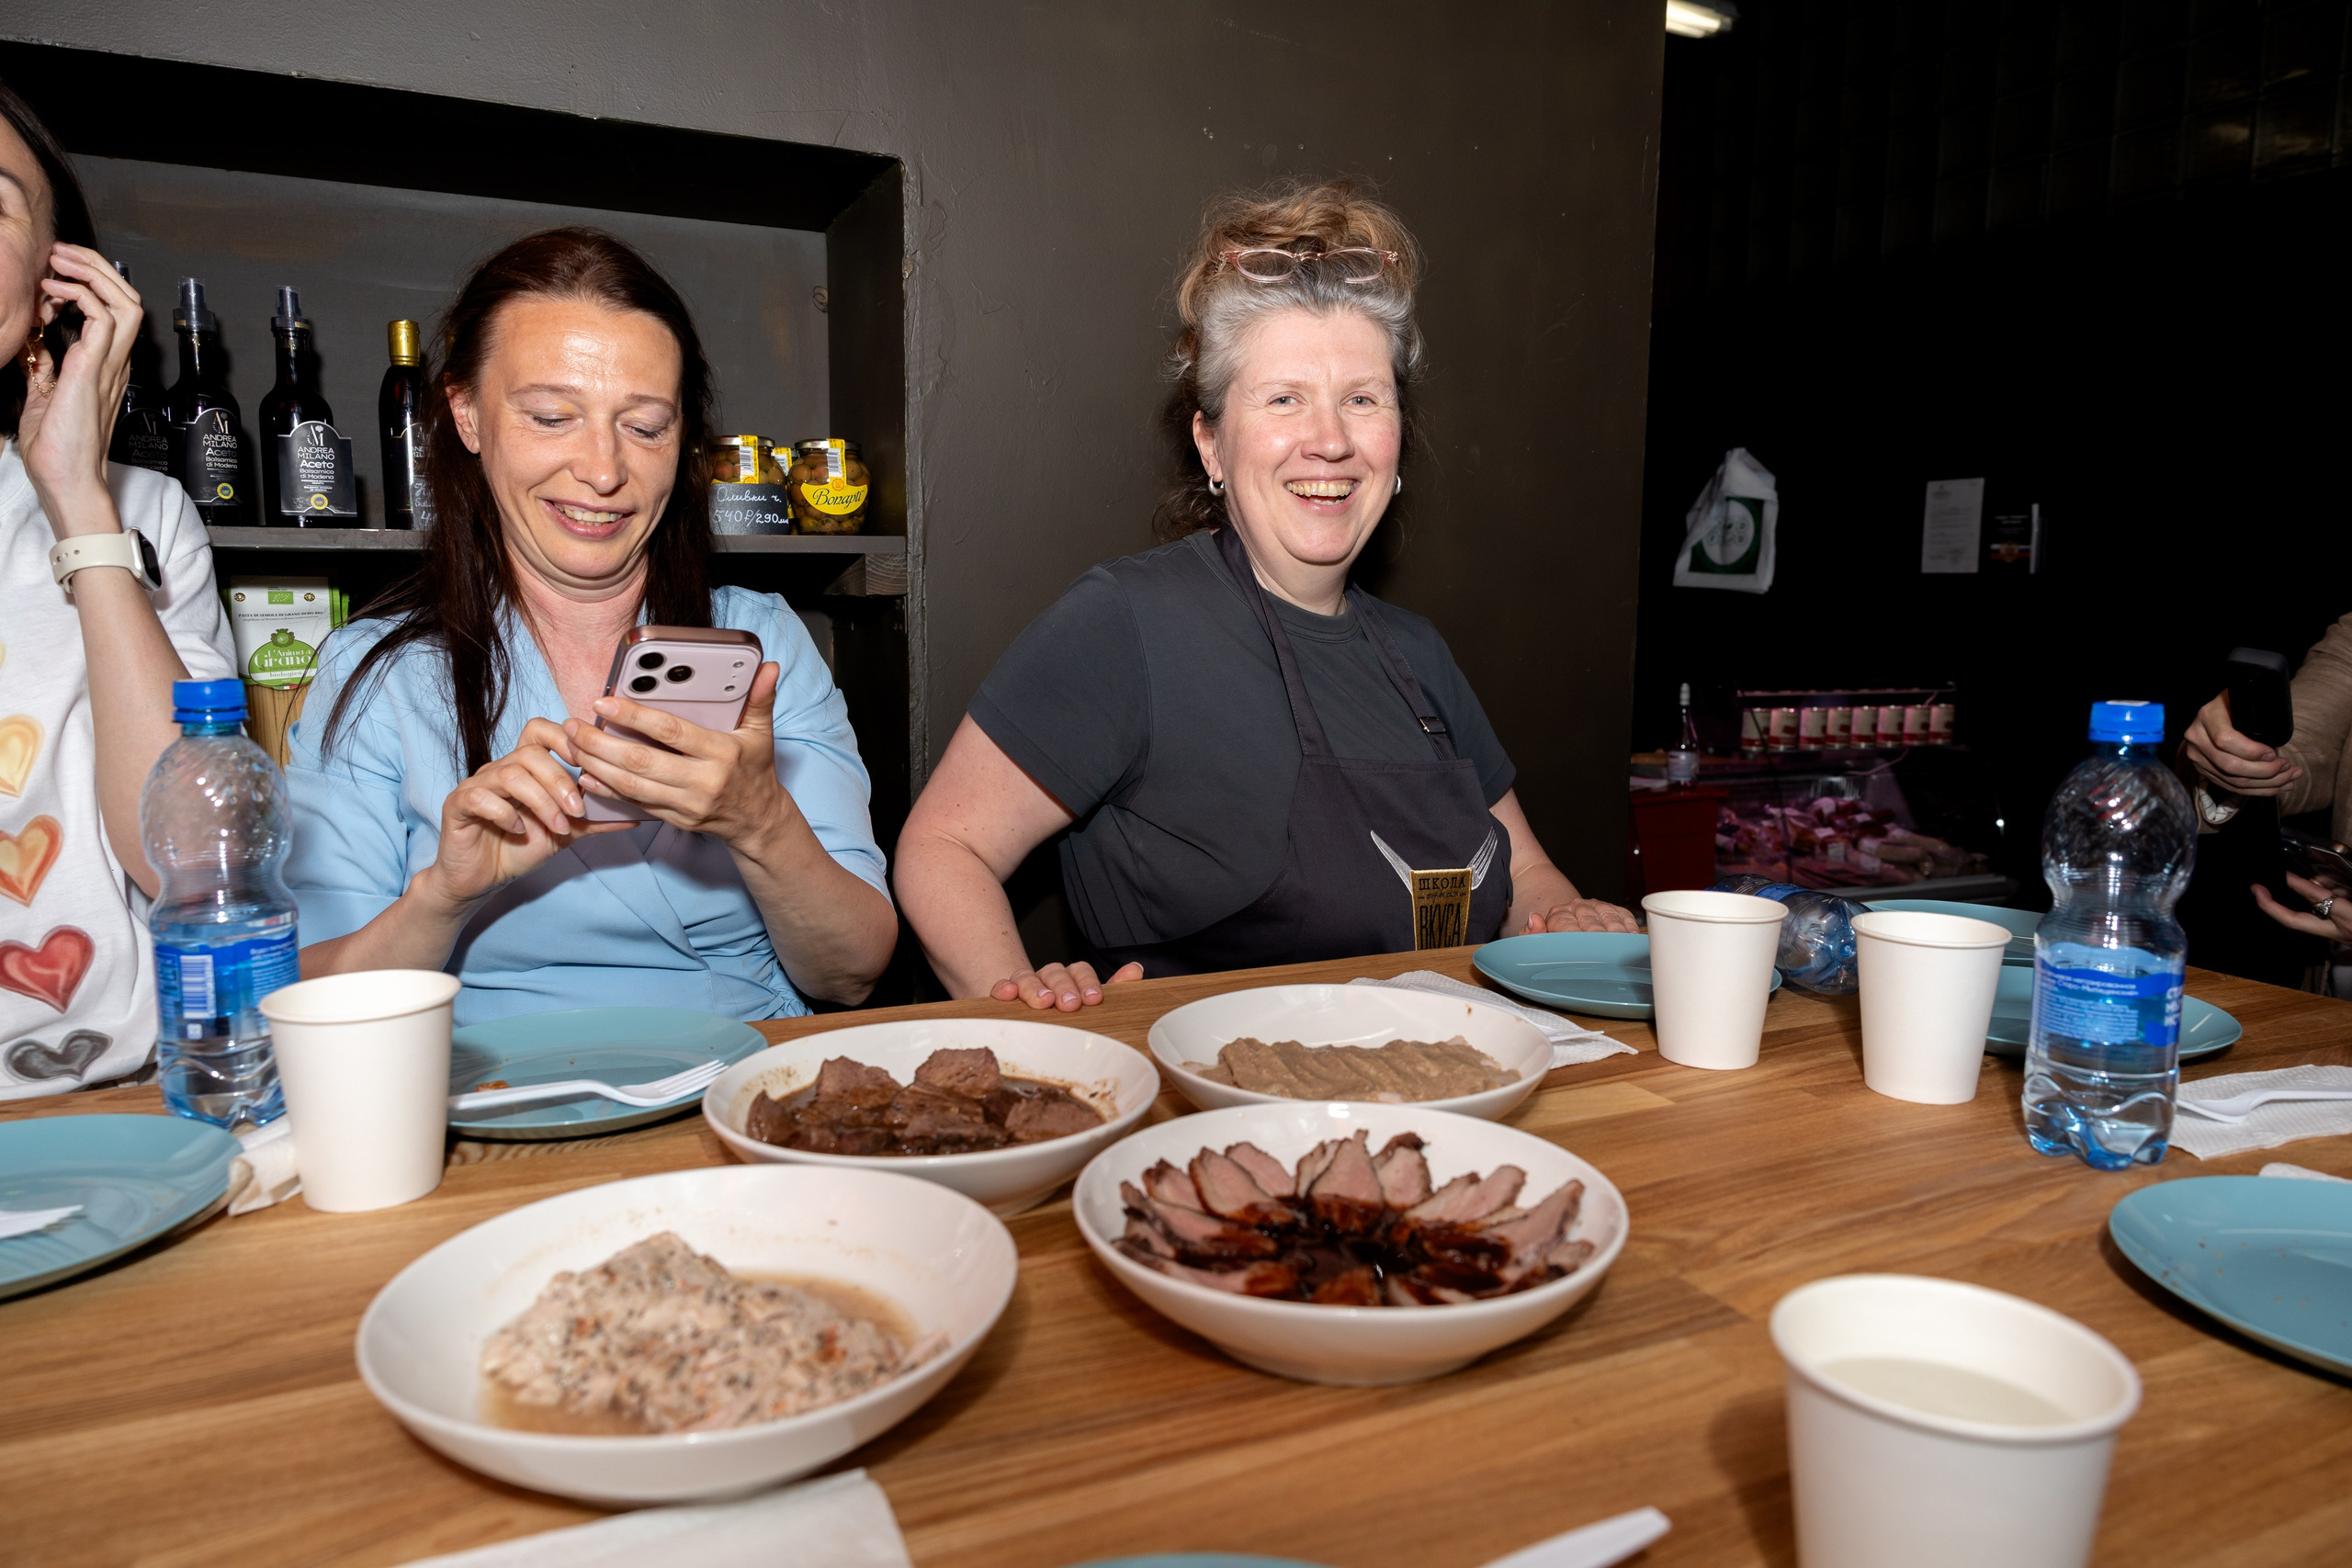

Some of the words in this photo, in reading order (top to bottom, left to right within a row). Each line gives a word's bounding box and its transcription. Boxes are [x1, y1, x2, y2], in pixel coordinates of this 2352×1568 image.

[129, 434, 168, 443] ANDREA
[203, 434, 237, 443] ANDREA
[129, 441, 169, 450] MILANO
[203, 441, 237, 449] MILANO
[131, 448, 167, 459] Aceto
[206, 447, 237, 457] Aceto
[300, 459, 334, 468] Aceto
[717, 487, 767, 502] Оливки
[254, 653, 311, 667] Grano
[1419, 877, 1465, 890] ШКОЛА
[1419, 903, 1460, 950] ВКУСА
